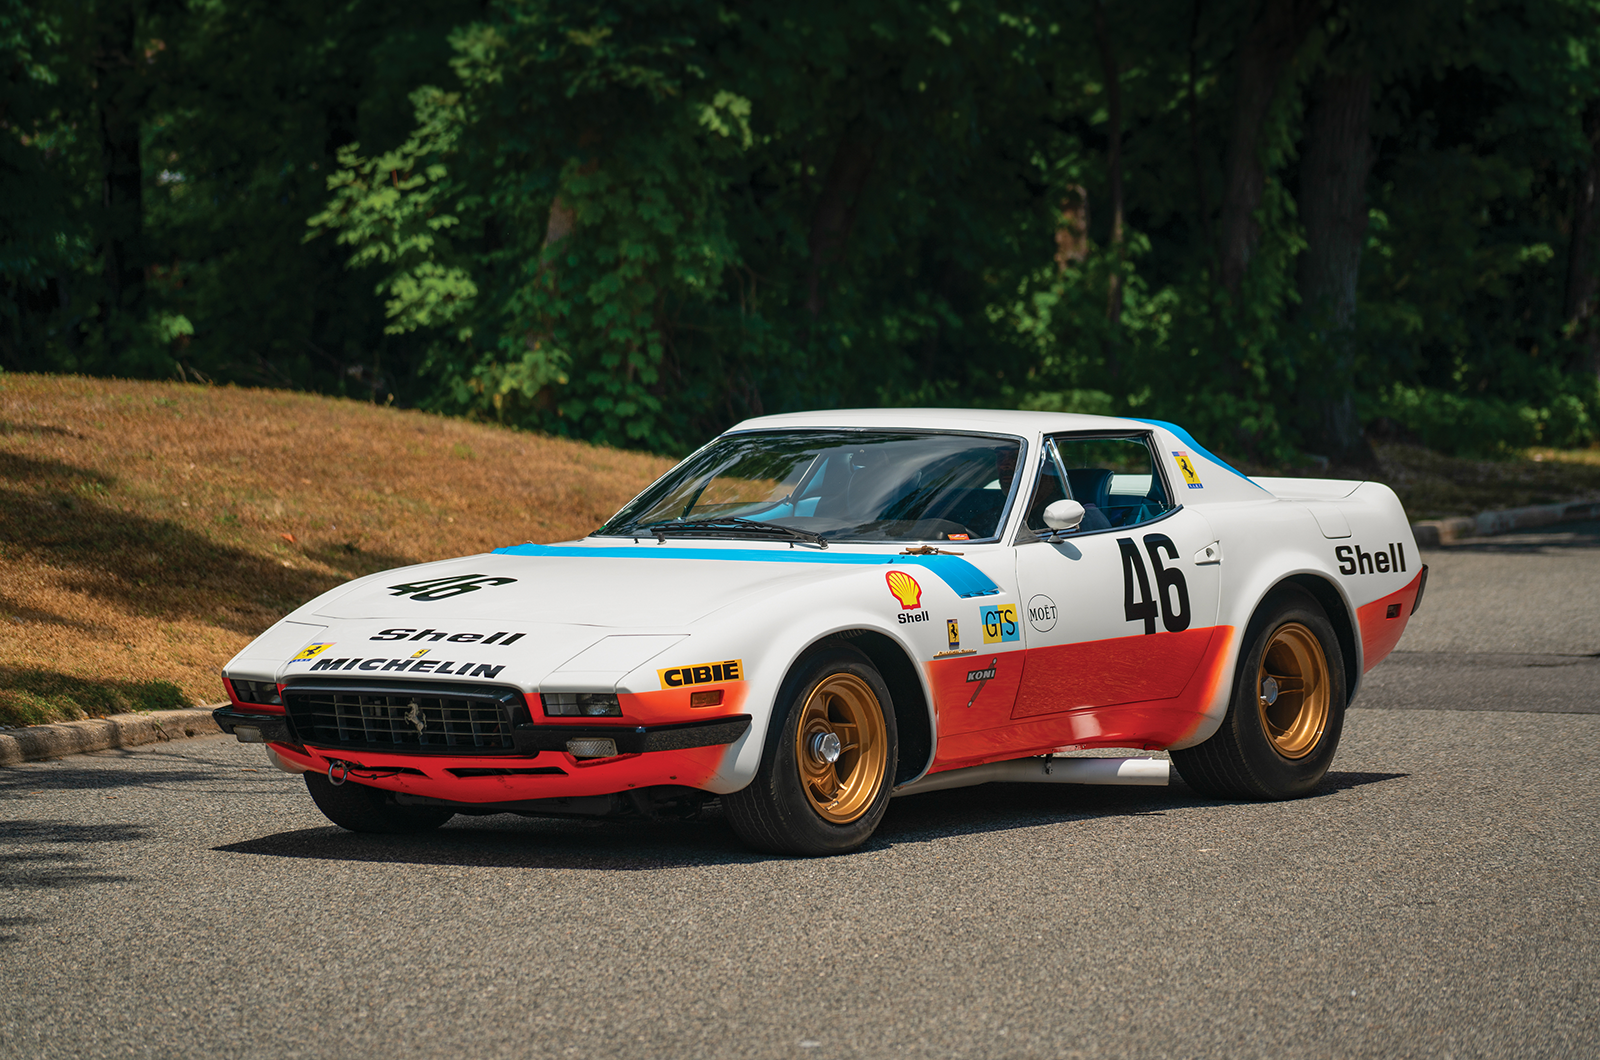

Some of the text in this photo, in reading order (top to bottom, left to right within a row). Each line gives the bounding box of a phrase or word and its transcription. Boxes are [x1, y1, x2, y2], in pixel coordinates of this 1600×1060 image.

[1335, 542, 1406, 576] Shell
[386, 573, 518, 602] 46
[1116, 533, 1191, 635] 46
[897, 610, 930, 624] Shell
[985, 609, 1016, 638] GTS
[369, 628, 527, 646] Shell
[309, 657, 507, 679] MICHELIN
[967, 669, 996, 681] KONI
